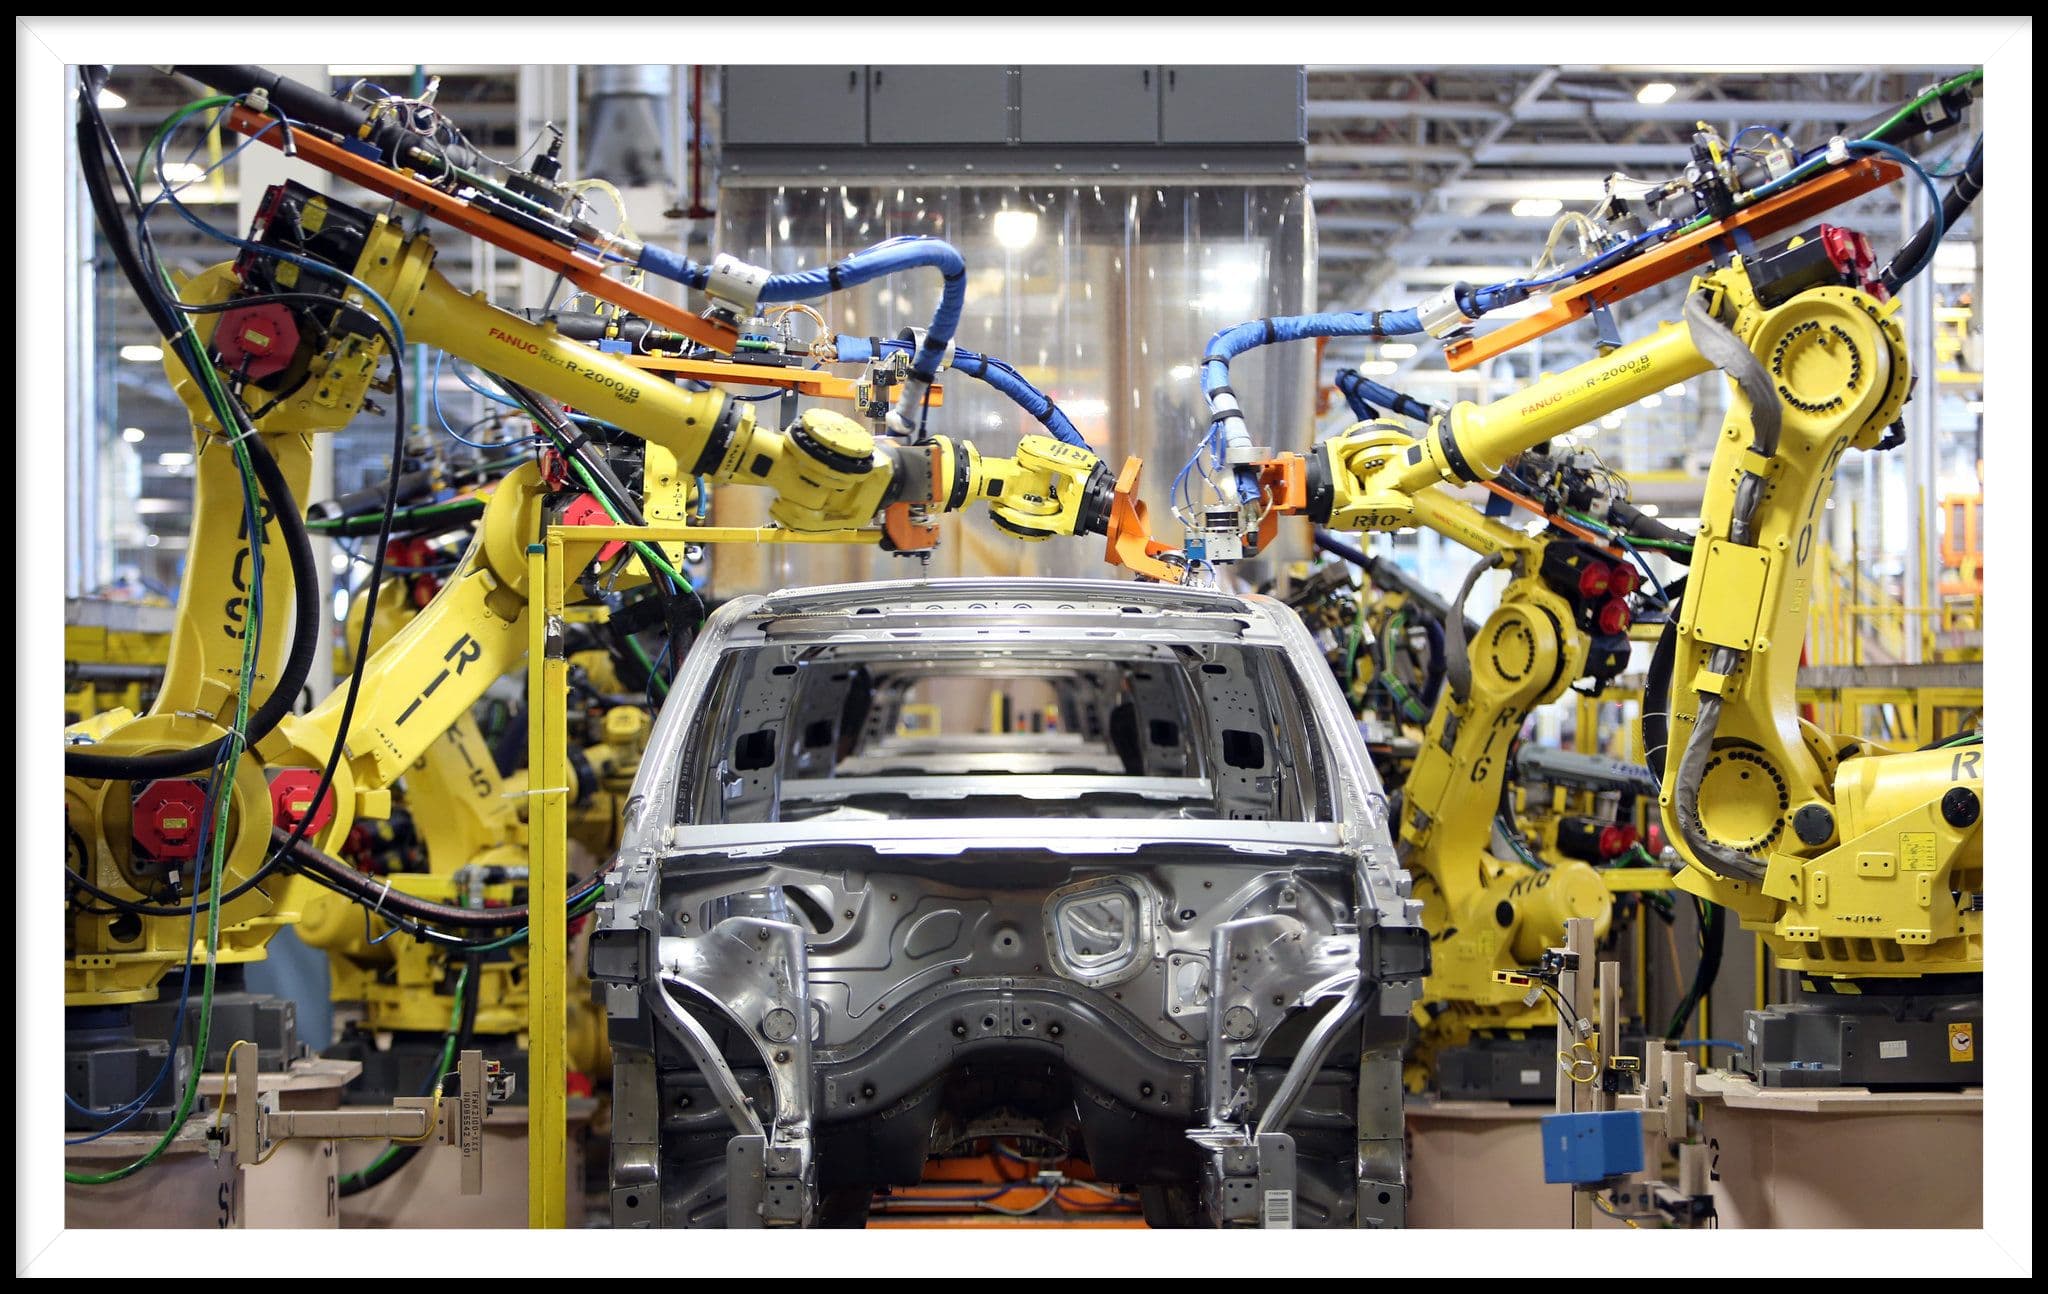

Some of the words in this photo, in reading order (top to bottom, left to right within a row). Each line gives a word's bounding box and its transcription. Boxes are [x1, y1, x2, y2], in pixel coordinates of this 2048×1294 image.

[488, 327, 539, 355] FANUC
[1521, 392, 1563, 416] FANUC
[1951, 751, 1981, 782] R
